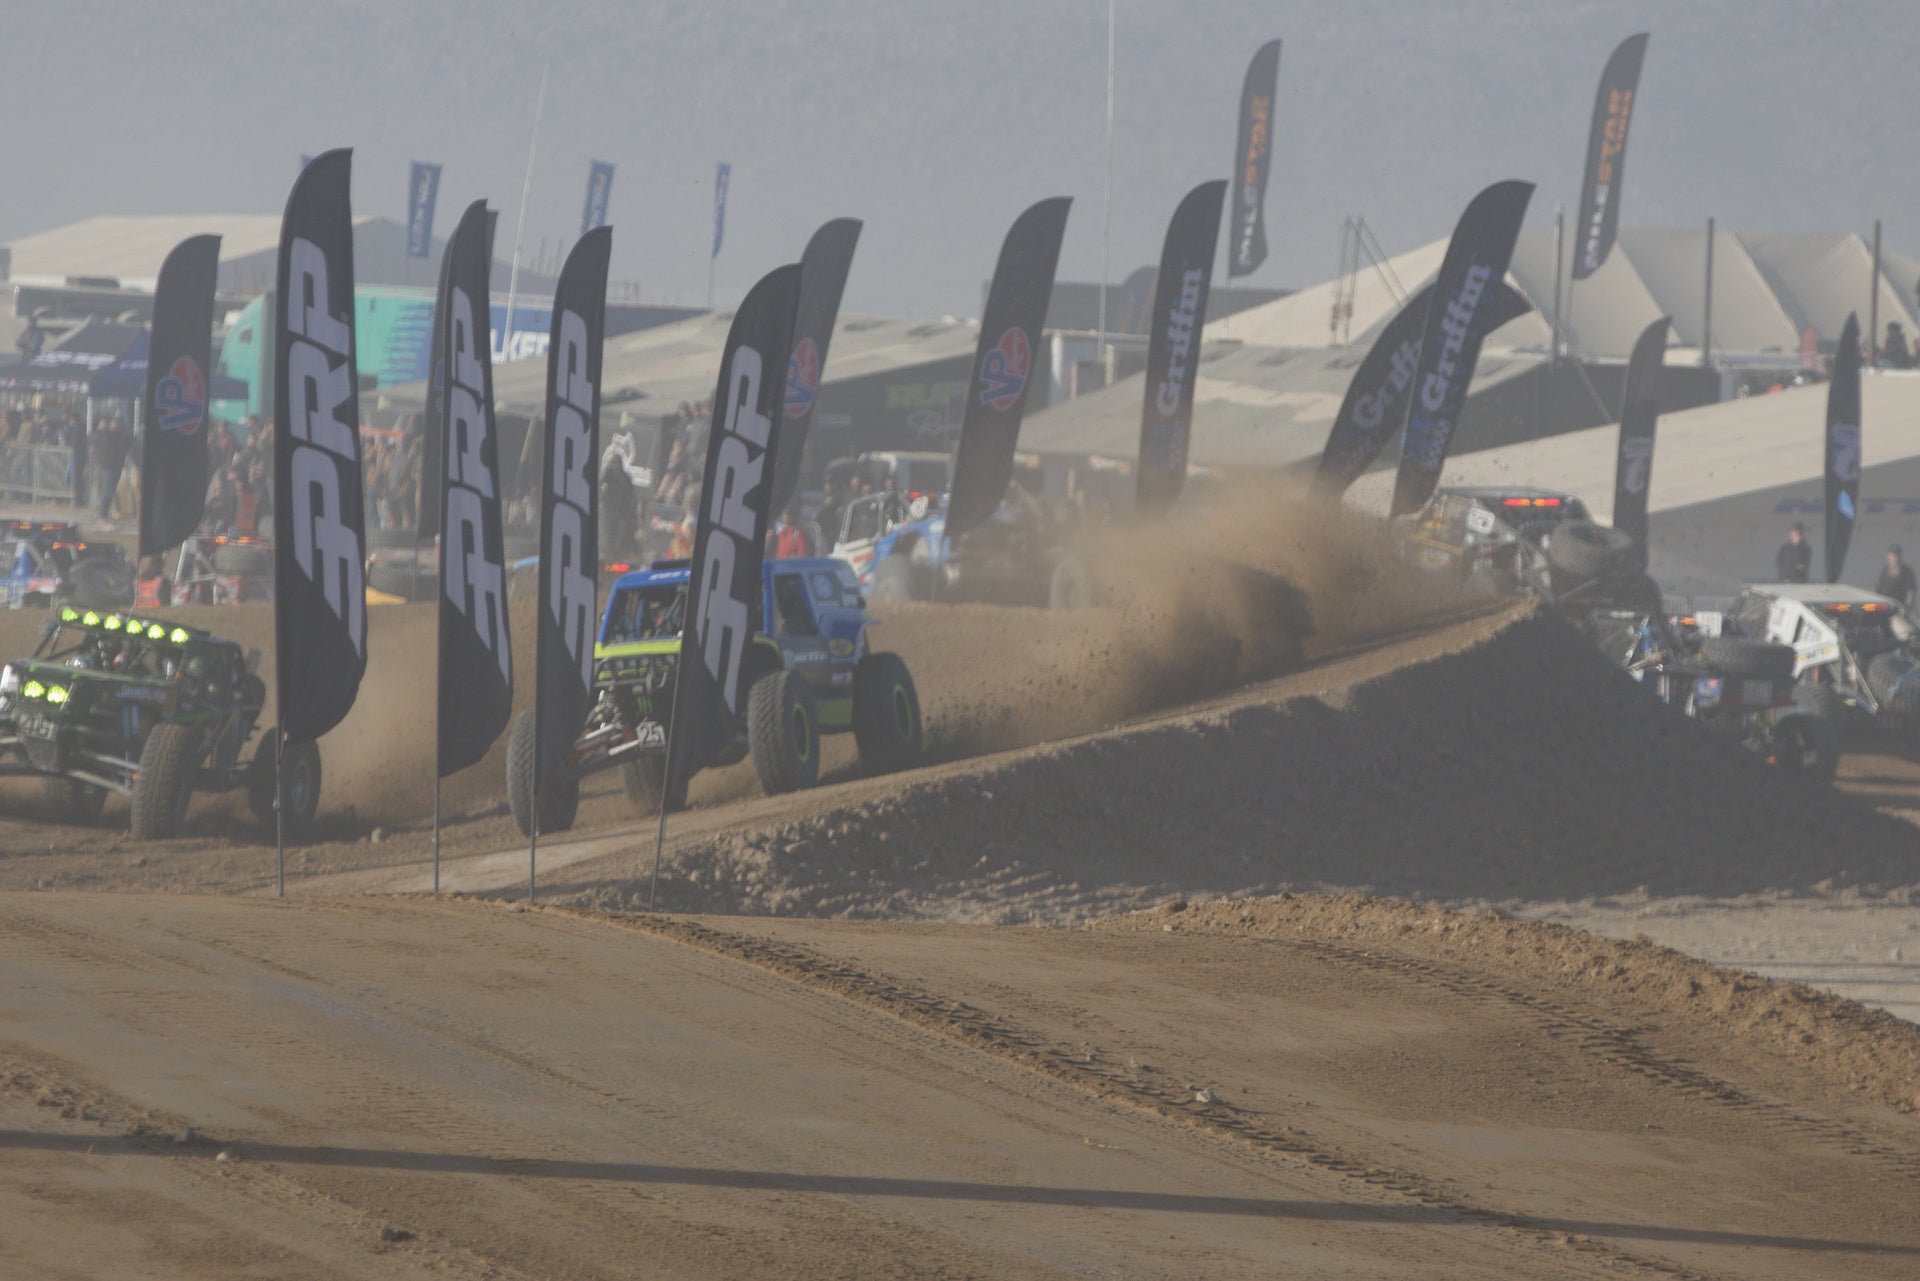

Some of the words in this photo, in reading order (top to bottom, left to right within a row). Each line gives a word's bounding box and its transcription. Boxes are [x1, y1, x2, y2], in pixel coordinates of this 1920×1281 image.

[156, 374, 203, 430] VP
[287, 236, 362, 658] PRP
[980, 348, 1026, 405] VP
[1156, 268, 1202, 416] Griffin
[1421, 264, 1492, 412] Griffin
[446, 286, 511, 687] PRP
[551, 308, 596, 694] PRP
[696, 344, 772, 718] PRP
